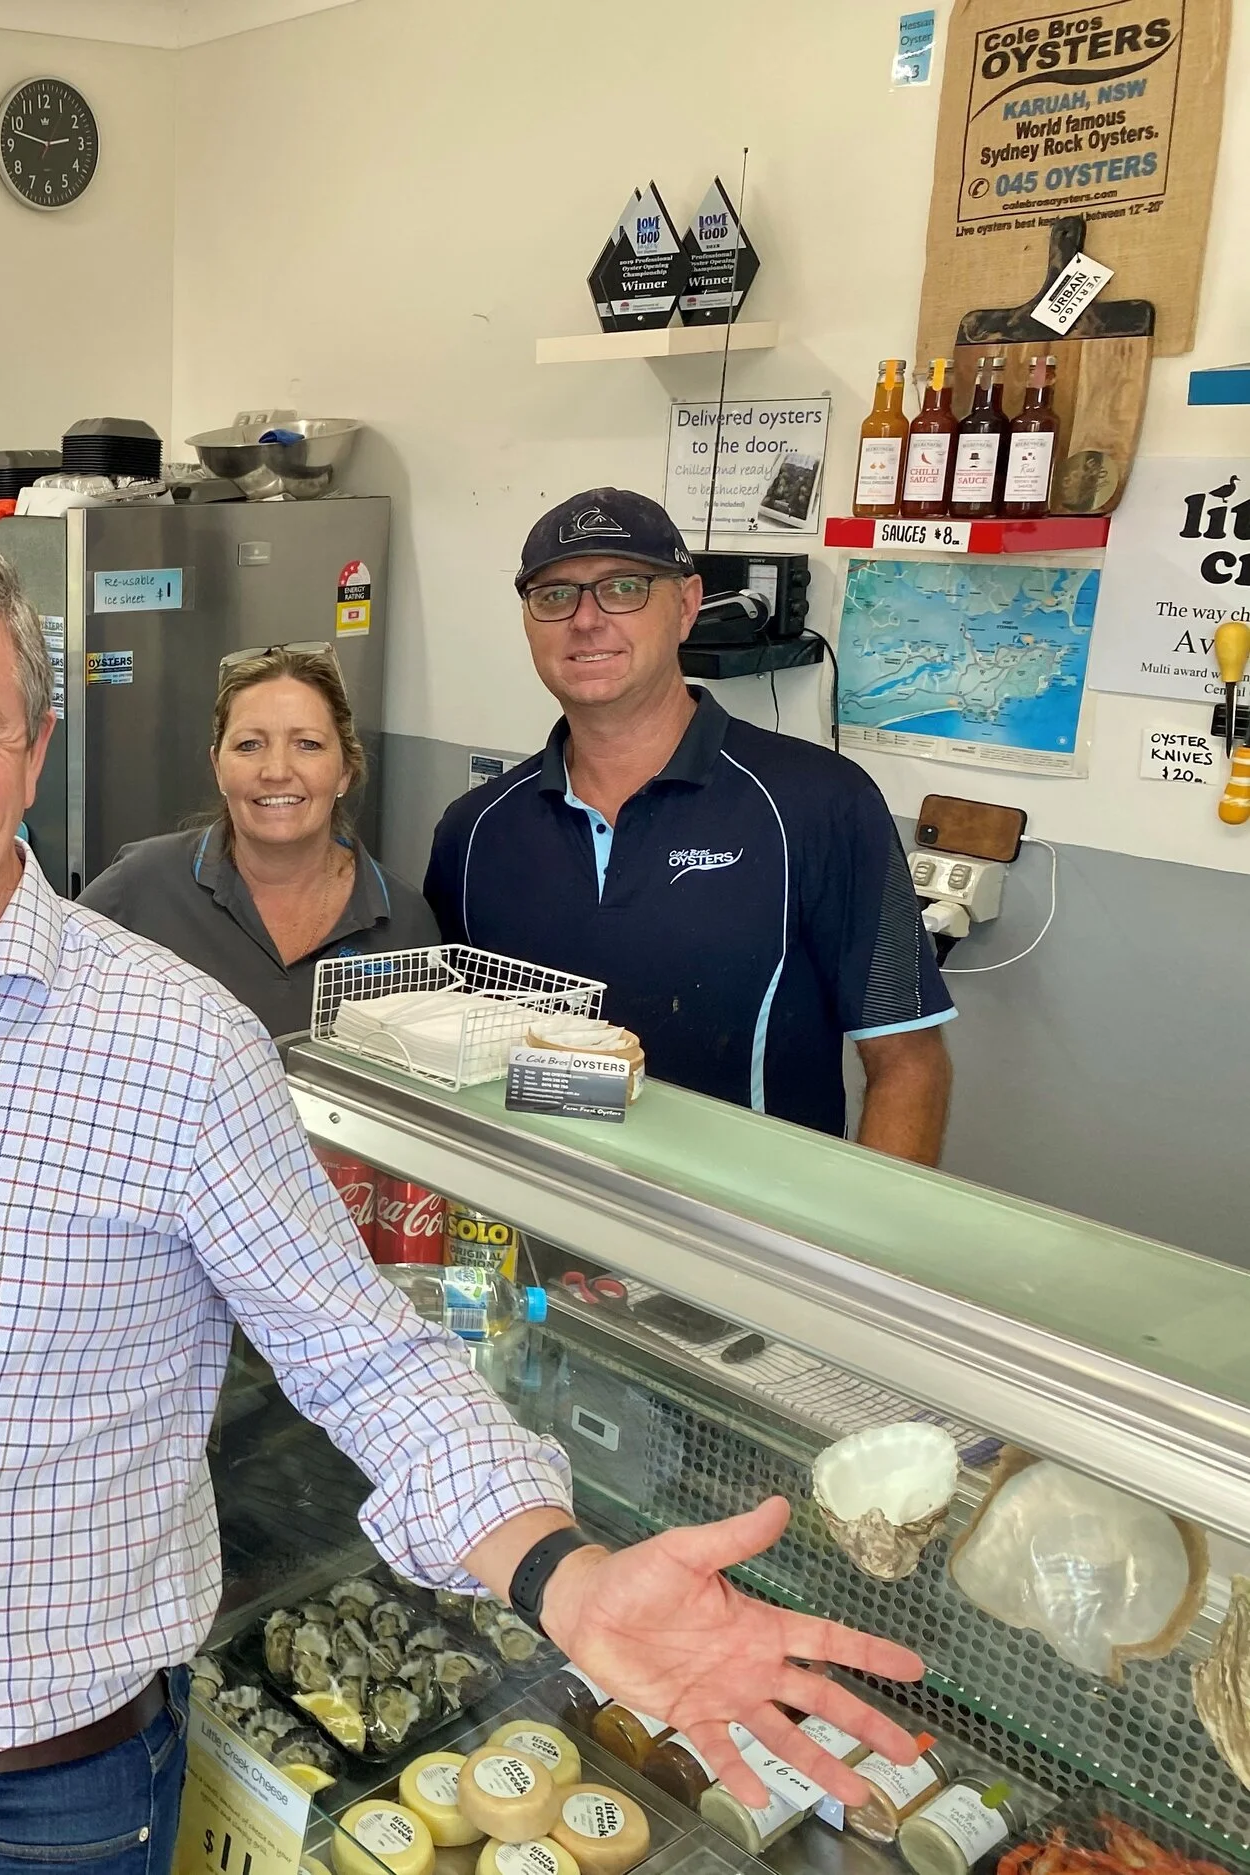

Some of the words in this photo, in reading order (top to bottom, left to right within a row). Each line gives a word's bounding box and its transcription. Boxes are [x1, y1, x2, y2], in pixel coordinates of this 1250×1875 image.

[900, 19, 934, 31] Hessian
[901, 33, 932, 46] Oyster
[984, 27, 1040, 52] Cole
[1048, 16, 1103, 39] Bros
[981, 18, 1171, 80] OYSTERS
[23, 99, 32, 114] 11
[38, 94, 50, 109] 12
[1002, 90, 1091, 121] KARUAH,
[1097, 78, 1147, 105] NSW
[11, 116, 24, 131] 10
[71, 114, 79, 129] 2
[1016, 116, 1061, 140] World
[1065, 110, 1126, 133] famous
[7, 138, 15, 152] 9
[77, 137, 85, 151] 3
[980, 143, 1039, 167] Sydney
[1043, 134, 1083, 156] Rock
[1088, 125, 1159, 152] Oysters.
[14, 160, 22, 174] 8
[72, 158, 80, 172] 4
[28, 175, 36, 189] 7
[61, 174, 69, 188] 5
[995, 171, 1038, 197] 045
[1045, 151, 1158, 190] OYSTERS
[44, 180, 52, 194] 6
[698, 212, 729, 227] LOVE
[1085, 208, 1126, 222] between
[637, 215, 661, 232] LOVE
[956, 226, 974, 237] Live
[977, 220, 1012, 235] oysters
[1014, 218, 1036, 229] best
[637, 230, 660, 244] FOOD
[699, 226, 728, 240] FOOD
[621, 280, 668, 292] Winner
[689, 276, 733, 287] Winner
[1050, 272, 1087, 313] URBAN
[1059, 275, 1101, 323] VERTIGO
[677, 408, 753, 427] Delivered
[758, 410, 822, 430] oysters
[692, 441, 708, 454] to
[675, 464, 711, 476] Chilled
[715, 464, 737, 476] and
[740, 464, 774, 481] ready
[957, 477, 988, 485] SAUCE
[687, 486, 697, 495] to
[700, 484, 711, 495] be
[881, 524, 927, 544] SAUCES
[104, 575, 155, 587] Re-usable
[345, 586, 366, 594] ENERGY
[104, 596, 118, 605] Ice
[120, 594, 146, 604] sheet
[1156, 601, 1188, 617] The
[1192, 606, 1227, 623] way
[88, 656, 133, 668] OYSTERS
[1140, 662, 1171, 675] Multi
[1174, 666, 1208, 679] award
[1150, 733, 1209, 751] OYSTER
[1151, 748, 1213, 765] KNIVES
[668, 852, 734, 867] OYSTERS
[526, 1054, 546, 1064] Cole
[547, 1056, 568, 1066] Bros
[573, 1059, 626, 1073] OYSTERS
[448, 1215, 509, 1244] SOLO
[450, 1247, 502, 1262] ORIGINAL
[531, 1735, 557, 1750] little
[532, 1741, 559, 1758] creek
[201, 1721, 222, 1748] Little
[223, 1742, 250, 1775] Creek
[251, 1767, 289, 1806] Cheese
[502, 1766, 527, 1795] creek
[508, 1759, 531, 1786] little
[595, 1805, 609, 1837] creek
[604, 1802, 619, 1831] little
[390, 1822, 414, 1842] creek
[391, 1815, 414, 1835] little
[529, 1852, 556, 1875] creek
[530, 1846, 555, 1865] little
